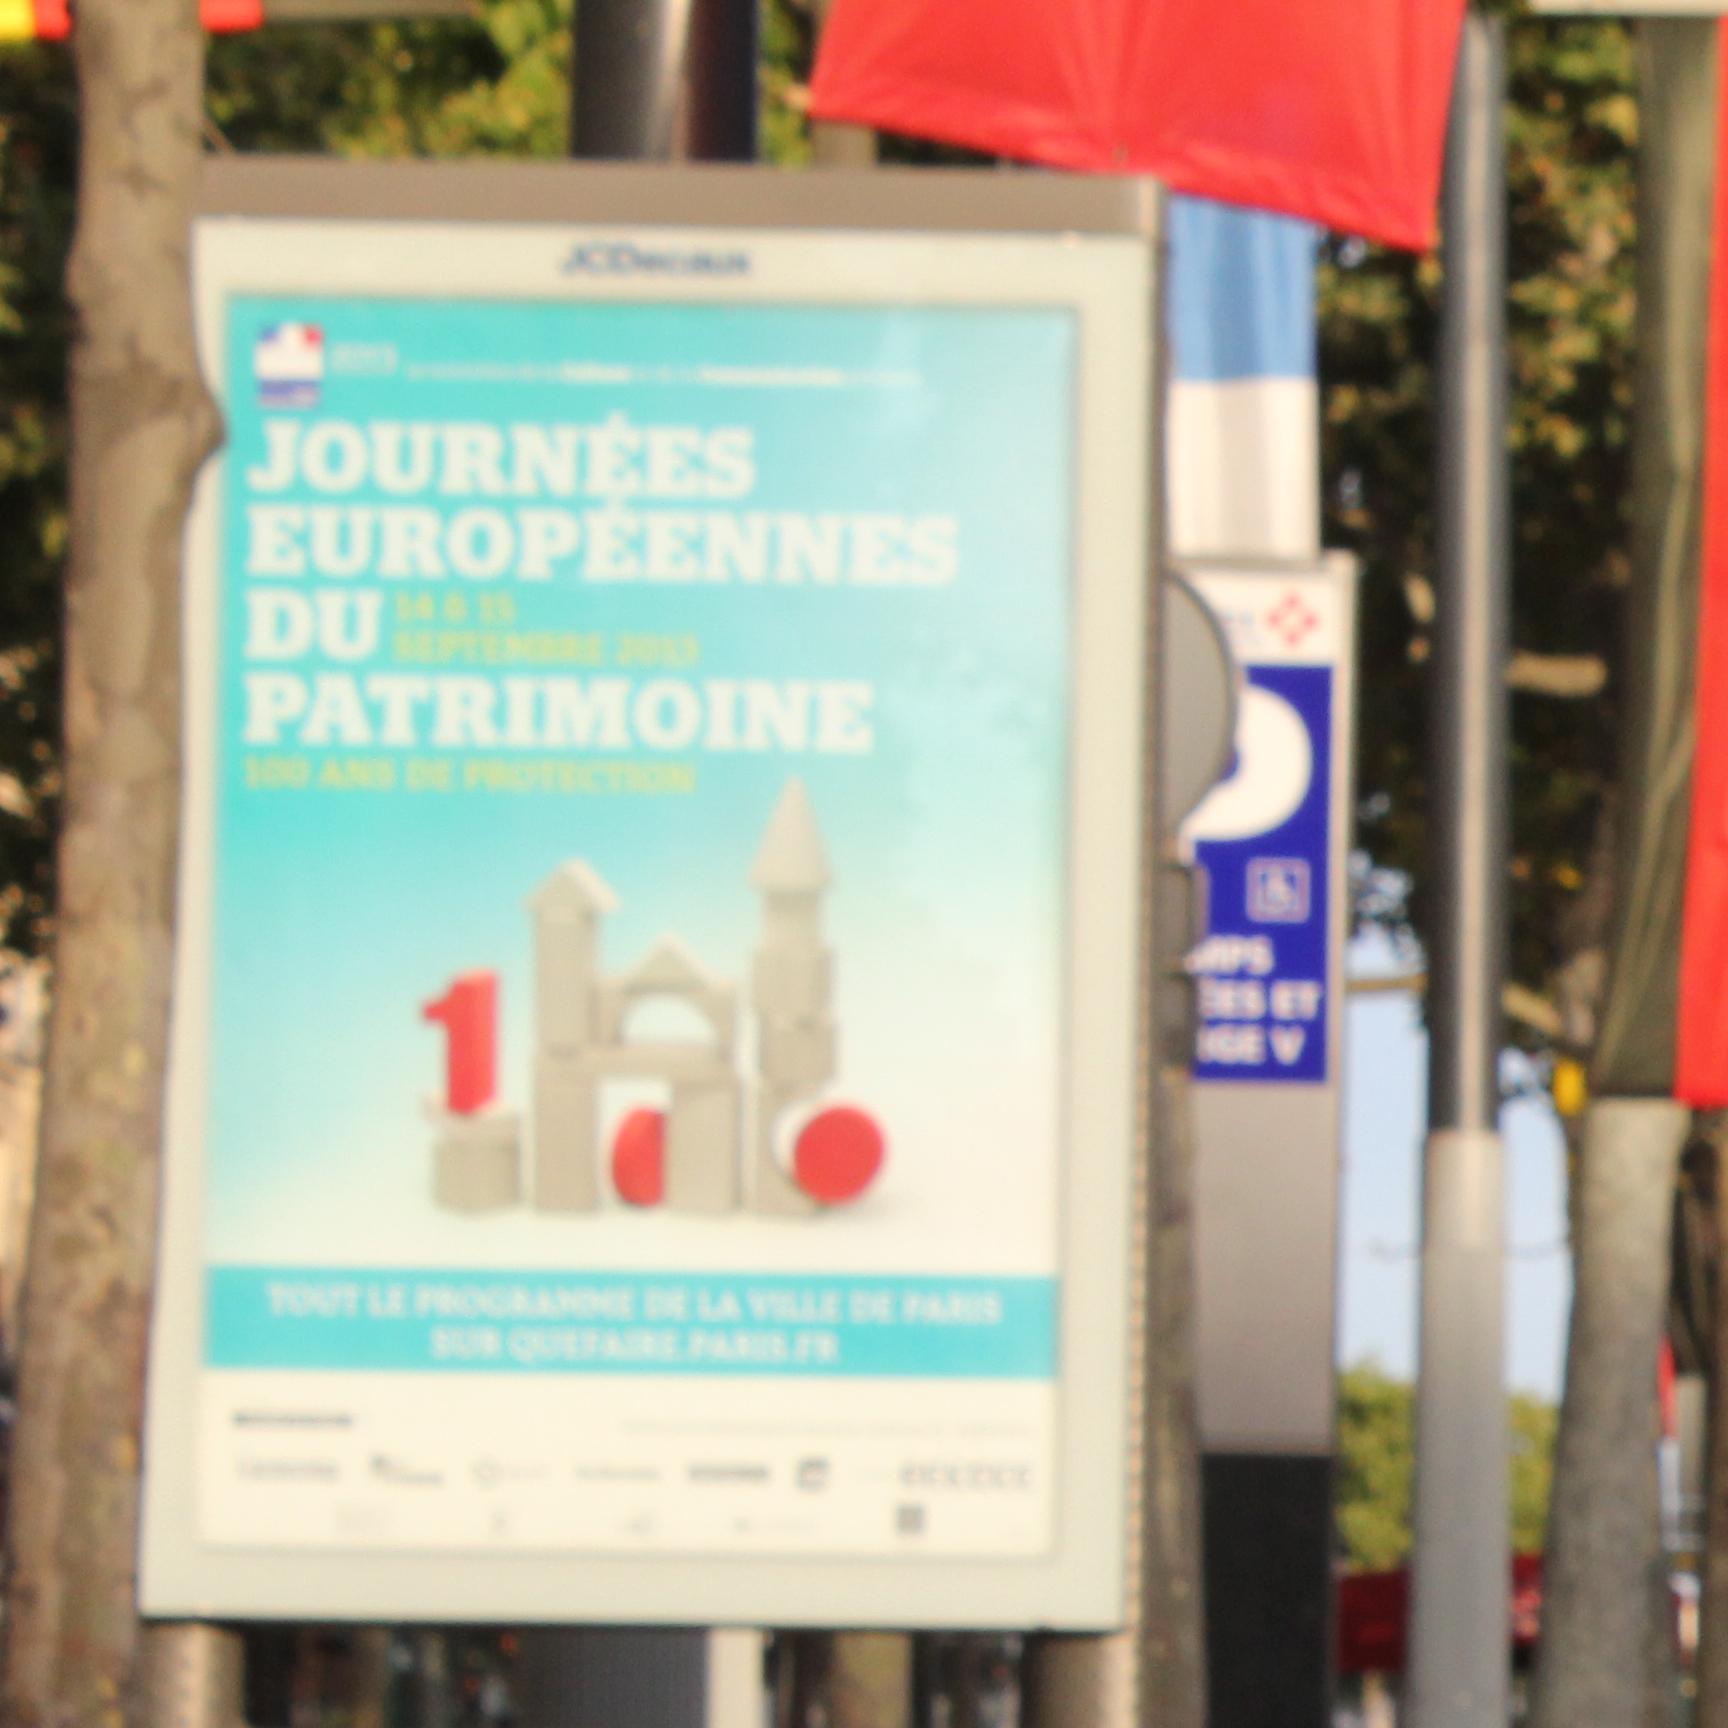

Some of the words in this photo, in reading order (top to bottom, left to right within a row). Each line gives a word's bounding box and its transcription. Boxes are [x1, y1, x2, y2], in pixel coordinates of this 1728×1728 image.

[246, 411, 757, 497] JOURNÉES
[245, 498, 959, 586] EUROPÉENNES
[244, 588, 383, 660] DU
[243, 672, 875, 753] PATRIMOINE
[404, 757, 455, 792] DE
[463, 757, 697, 794] PROTECTION
[267, 1281, 359, 1320] TOUT
[365, 1283, 405, 1319] LE
[413, 1284, 636, 1321] PROGRAMME
[643, 1286, 689, 1322] DE
[697, 1286, 742, 1323] LA
[746, 1287, 843, 1324] VILLE
[848, 1288, 896, 1325] DE
[903, 1289, 1003, 1327] PARIS
[430, 1325, 501, 1360] SUR
